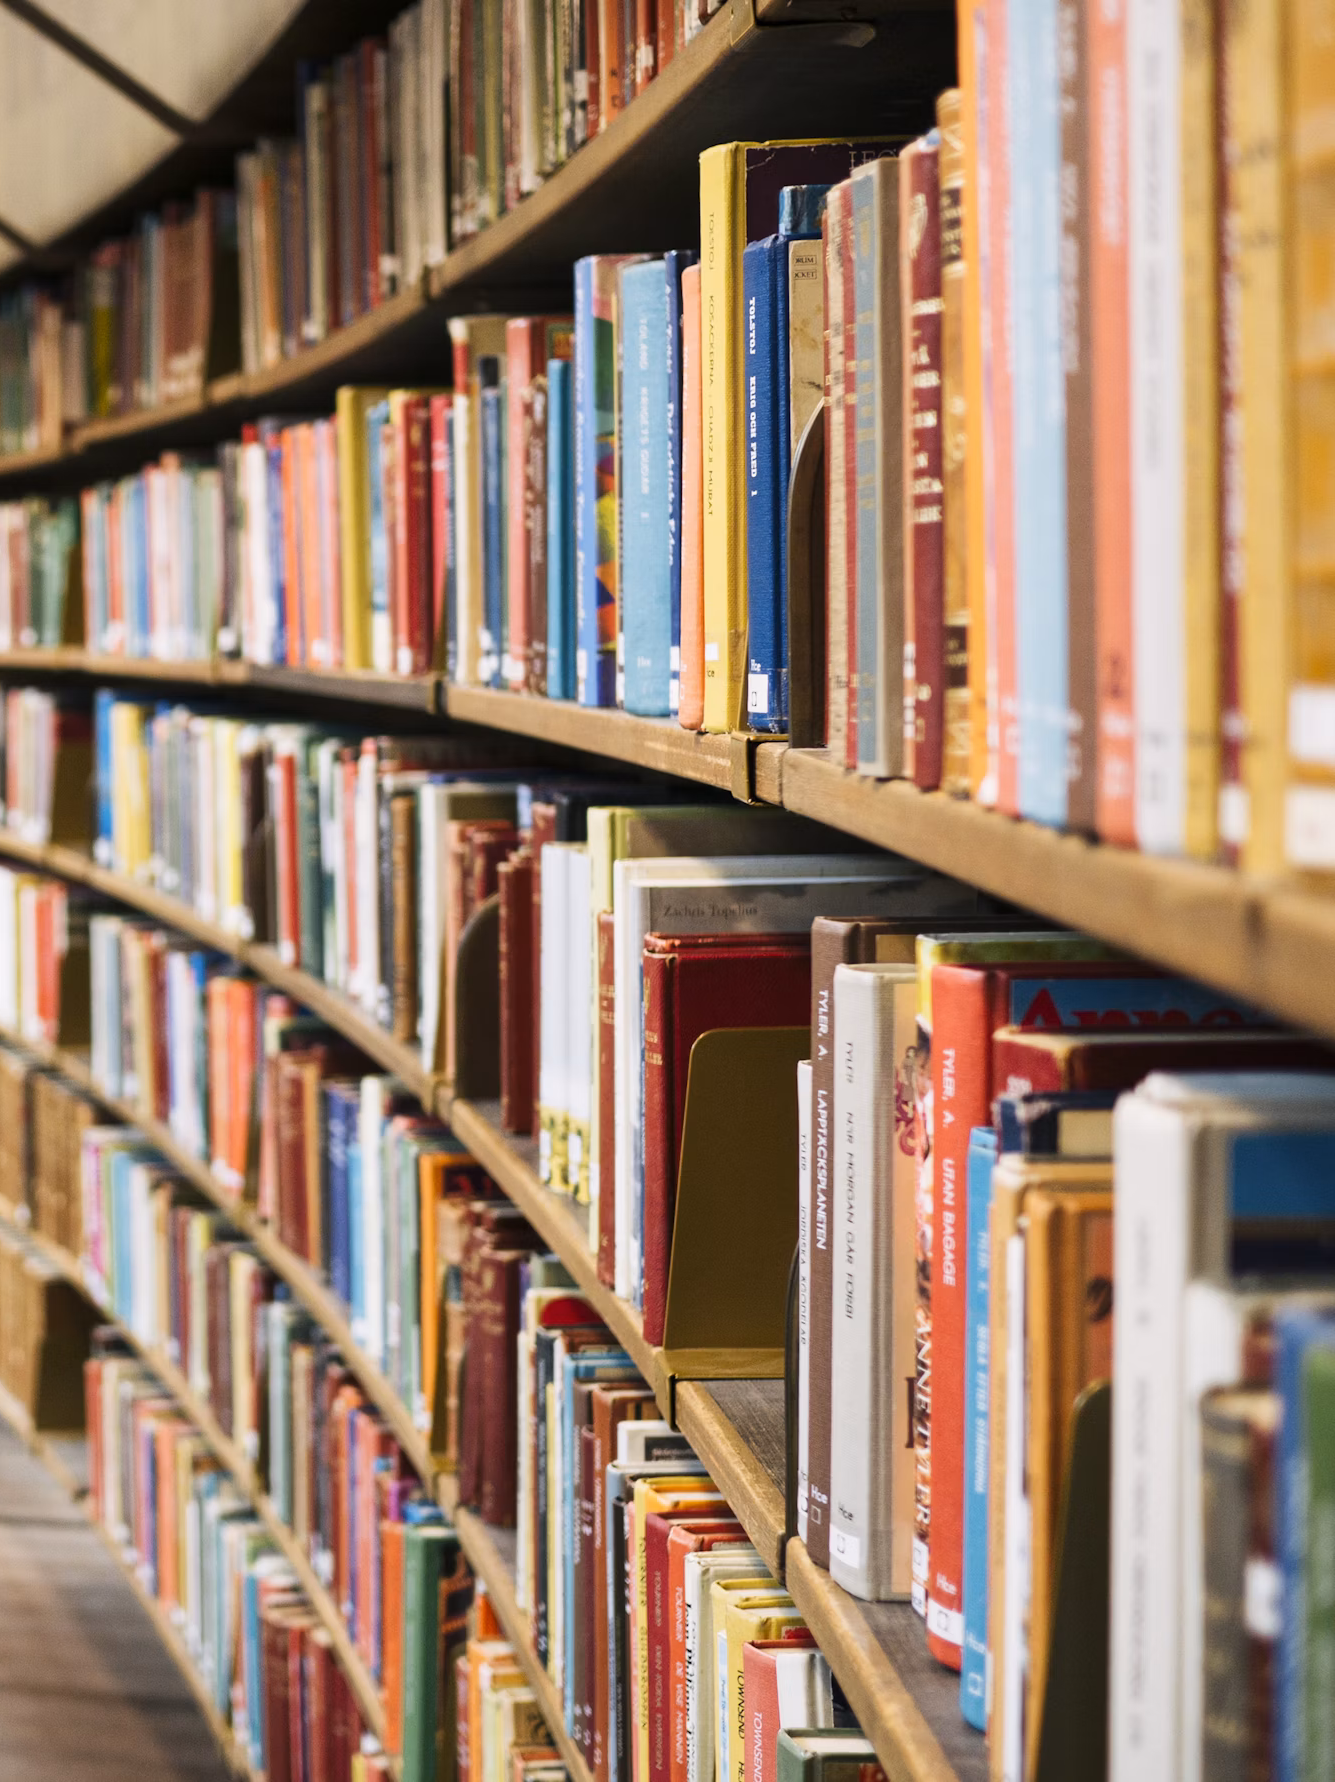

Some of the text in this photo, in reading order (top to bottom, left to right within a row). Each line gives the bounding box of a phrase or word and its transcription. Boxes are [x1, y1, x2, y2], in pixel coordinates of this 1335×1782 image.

[748, 297, 756, 355] TOLSTOJ
[749, 376, 757, 408] KRIG
[750, 442, 758, 478] FRED
[817, 989, 829, 1037] TYLER,
[817, 1044, 829, 1061] A.
[845, 1041, 855, 1085] TYLER
[845, 1151, 856, 1225] MORGAN
[941, 1047, 957, 1288] TYLER, A. UTAN BAGAGE
[914, 1306, 933, 1527] ANNE TYLER
[810, 1483, 829, 1505] Hce
[837, 1500, 854, 1521] Hce
[936, 1571, 958, 1595] Hce
[675, 1586, 684, 1643] TOURNIER
[737, 1669, 745, 1740] TOWNSEND
[753, 1711, 763, 1782] TOWNSEND
